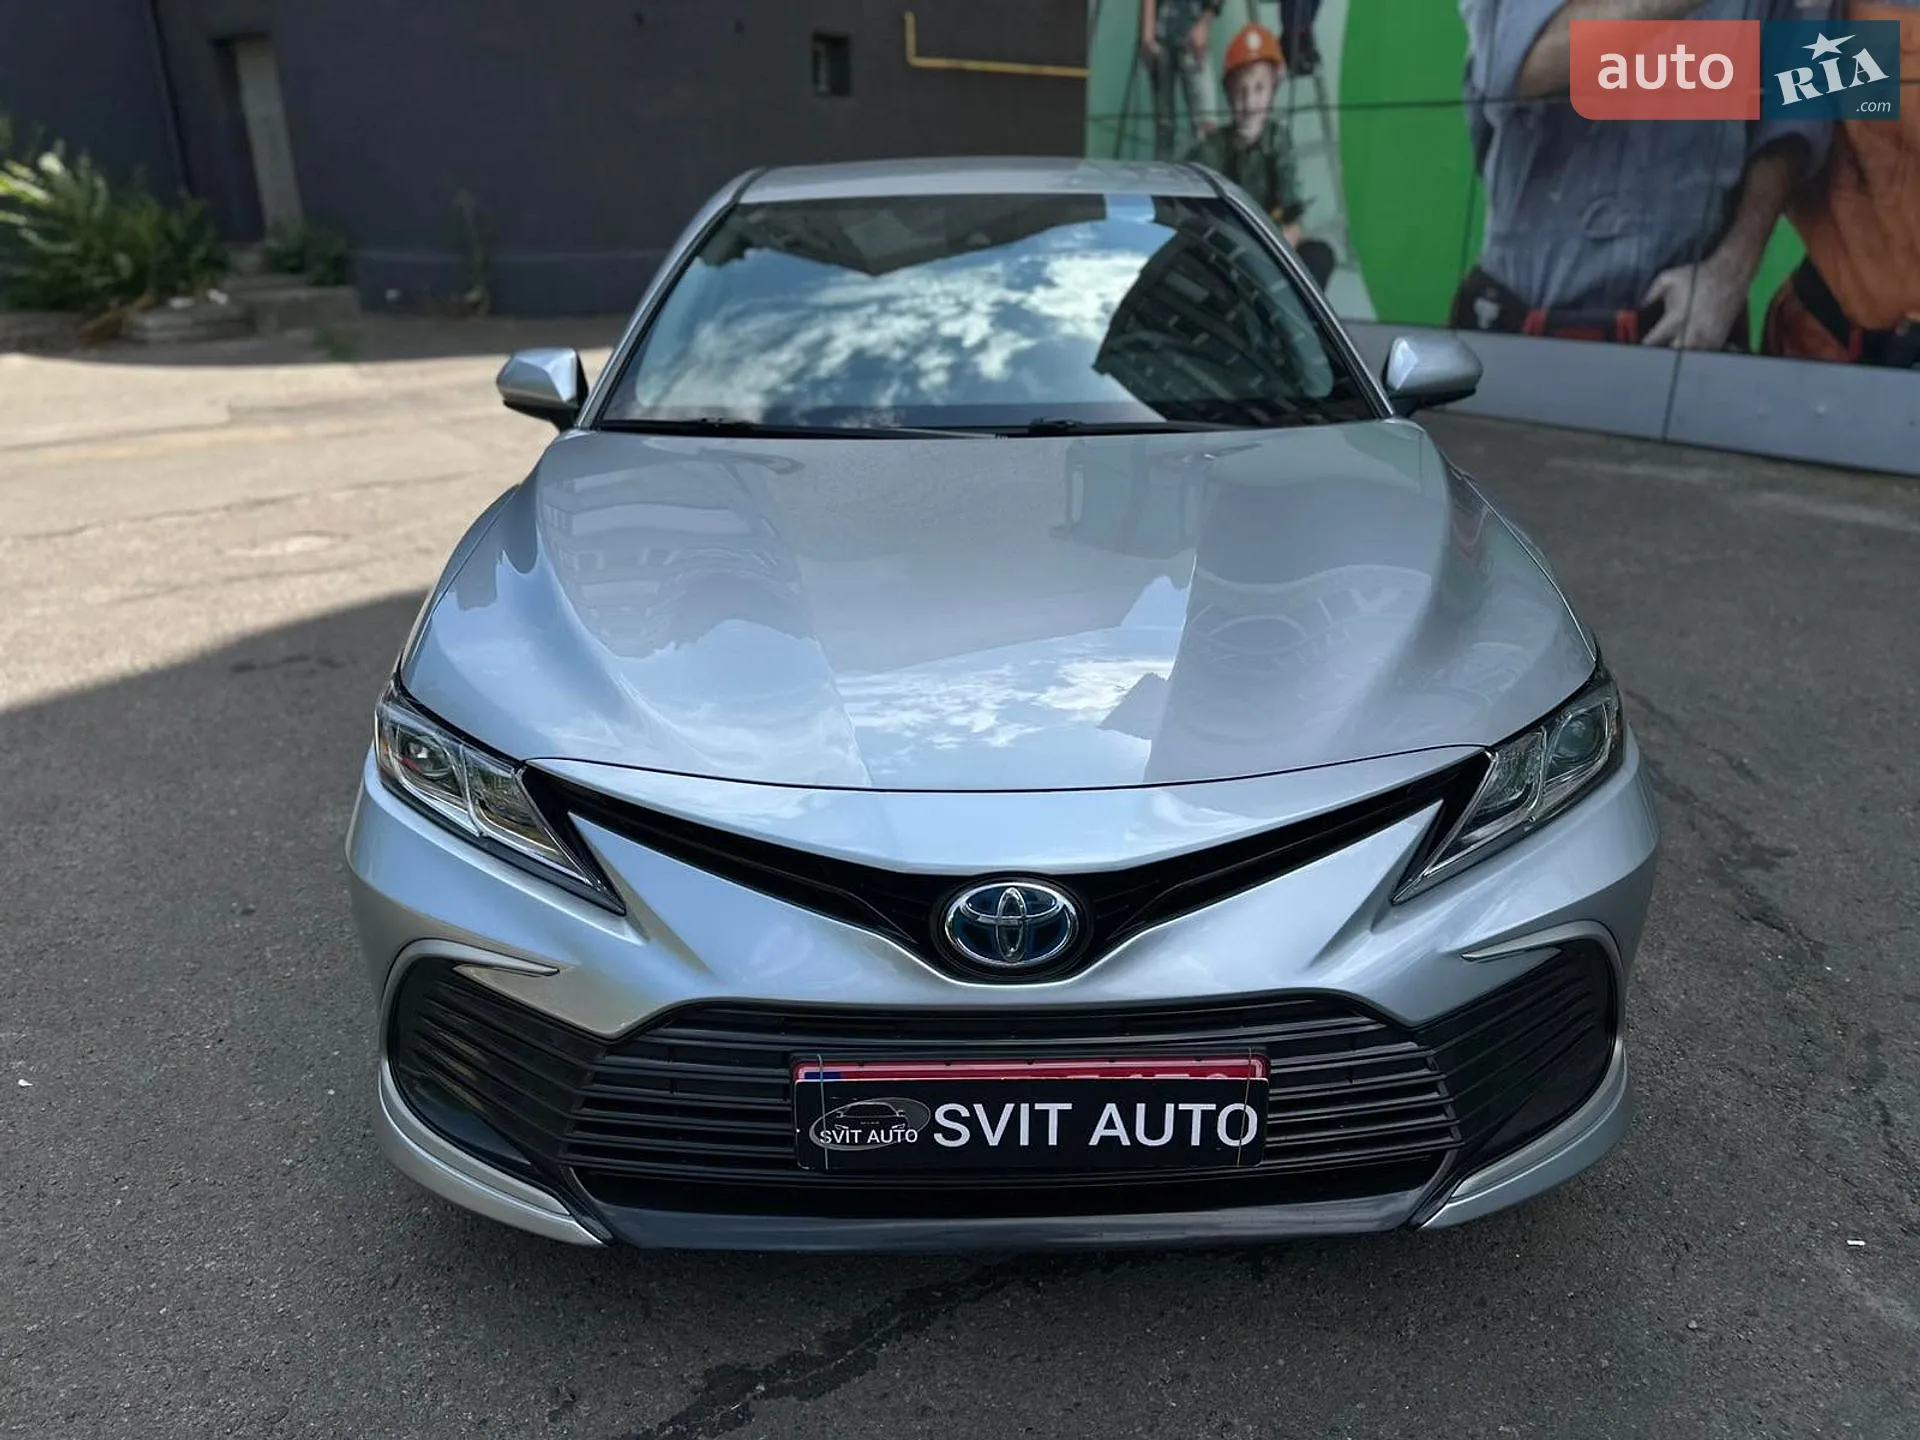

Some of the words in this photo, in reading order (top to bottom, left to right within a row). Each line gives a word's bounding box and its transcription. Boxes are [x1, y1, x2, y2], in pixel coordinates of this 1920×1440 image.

[819, 1129, 863, 1144] SVIT
[866, 1128, 918, 1144] AUTO
[933, 1101, 1073, 1147] SVIT
[1088, 1101, 1259, 1147] AUTO
